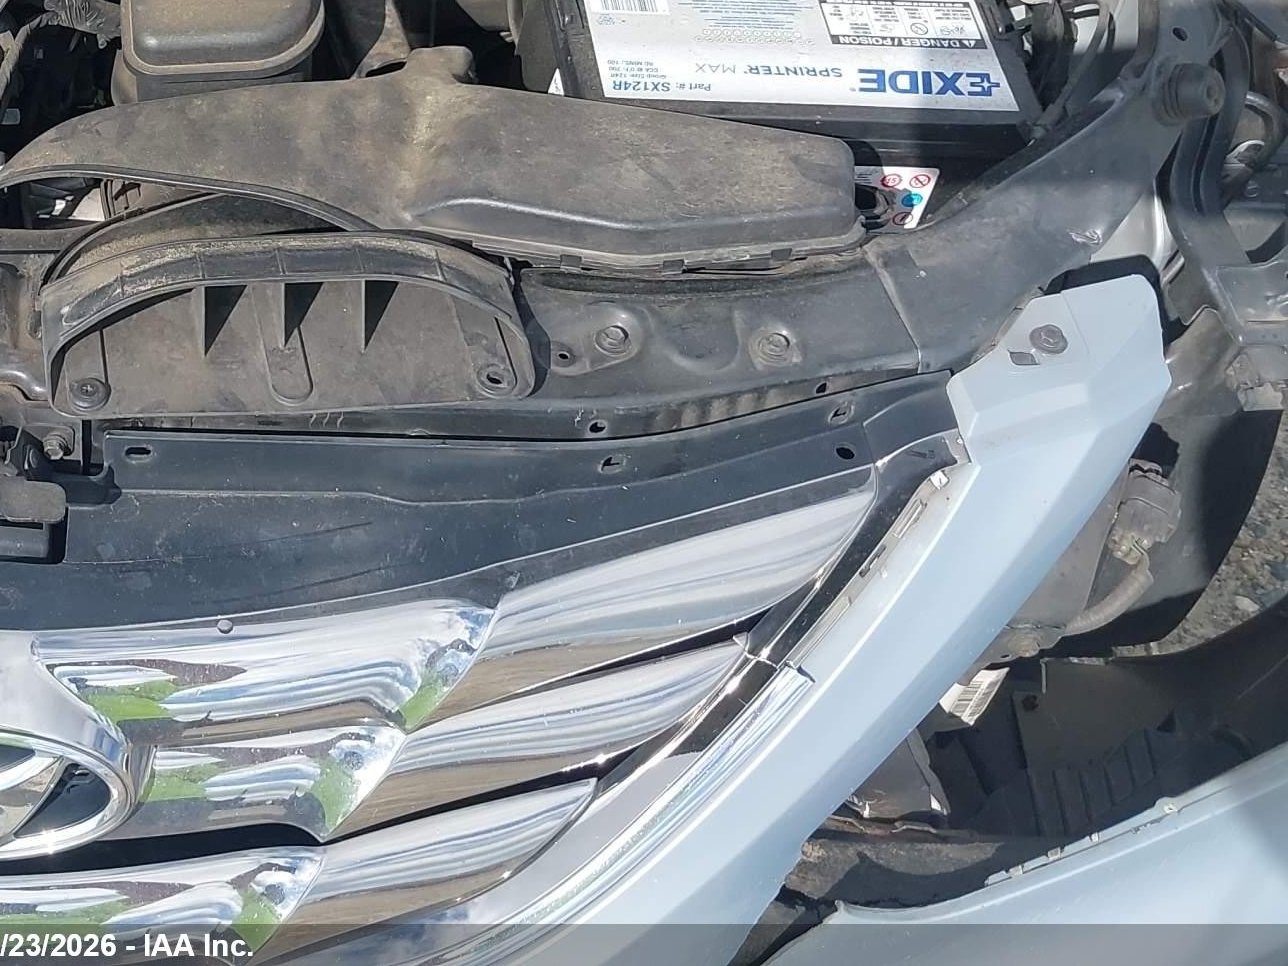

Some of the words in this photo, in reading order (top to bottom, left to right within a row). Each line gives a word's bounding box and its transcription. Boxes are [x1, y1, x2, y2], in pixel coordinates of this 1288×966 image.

[839, 36, 893, 45] POISON
[902, 37, 960, 48] DANGER
[695, 63, 736, 74] MAX
[612, 80, 671, 92] SX124R
[689, 82, 711, 91] Part
[858, 69, 1000, 97] EXIDE
